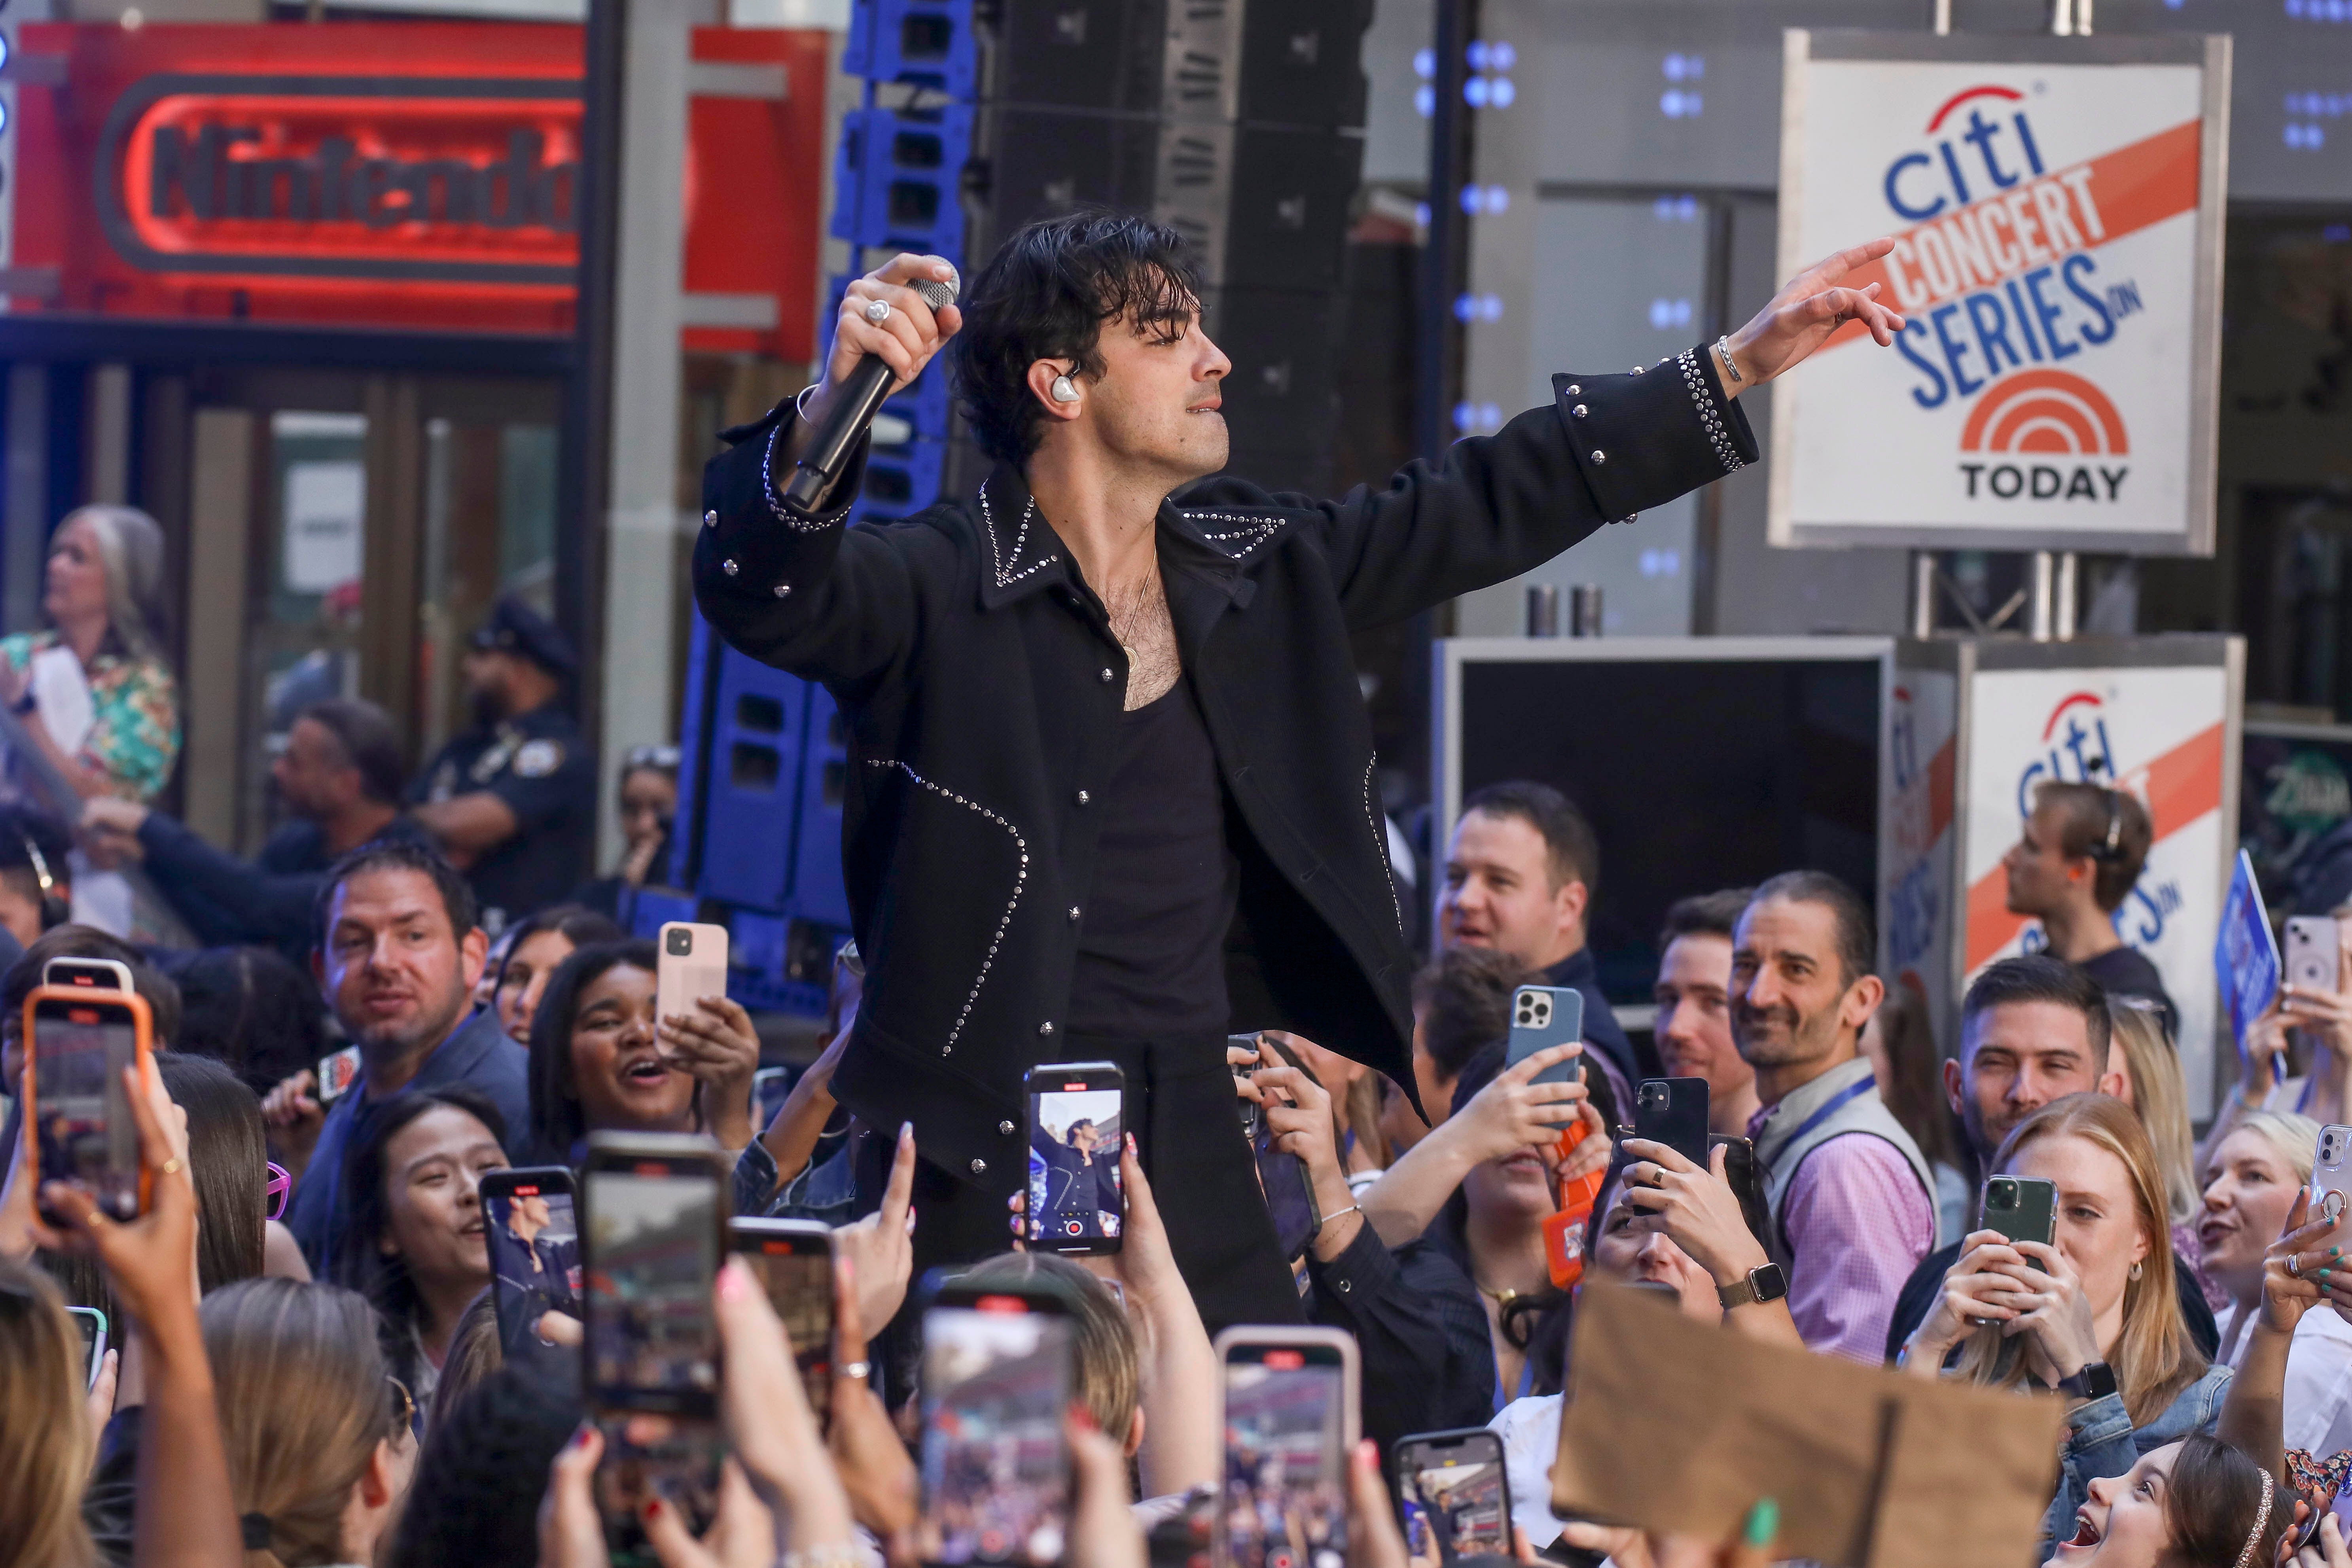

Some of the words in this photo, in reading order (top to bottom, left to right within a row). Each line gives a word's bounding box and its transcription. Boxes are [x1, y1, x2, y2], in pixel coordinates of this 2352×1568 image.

[1882, 106, 2046, 223] citi
[1884, 166, 2105, 311] CONCERT
[1893, 251, 2117, 411] SERIES
[2104, 278, 2144, 320] ON
[1958, 464, 2130, 503] TODAY
